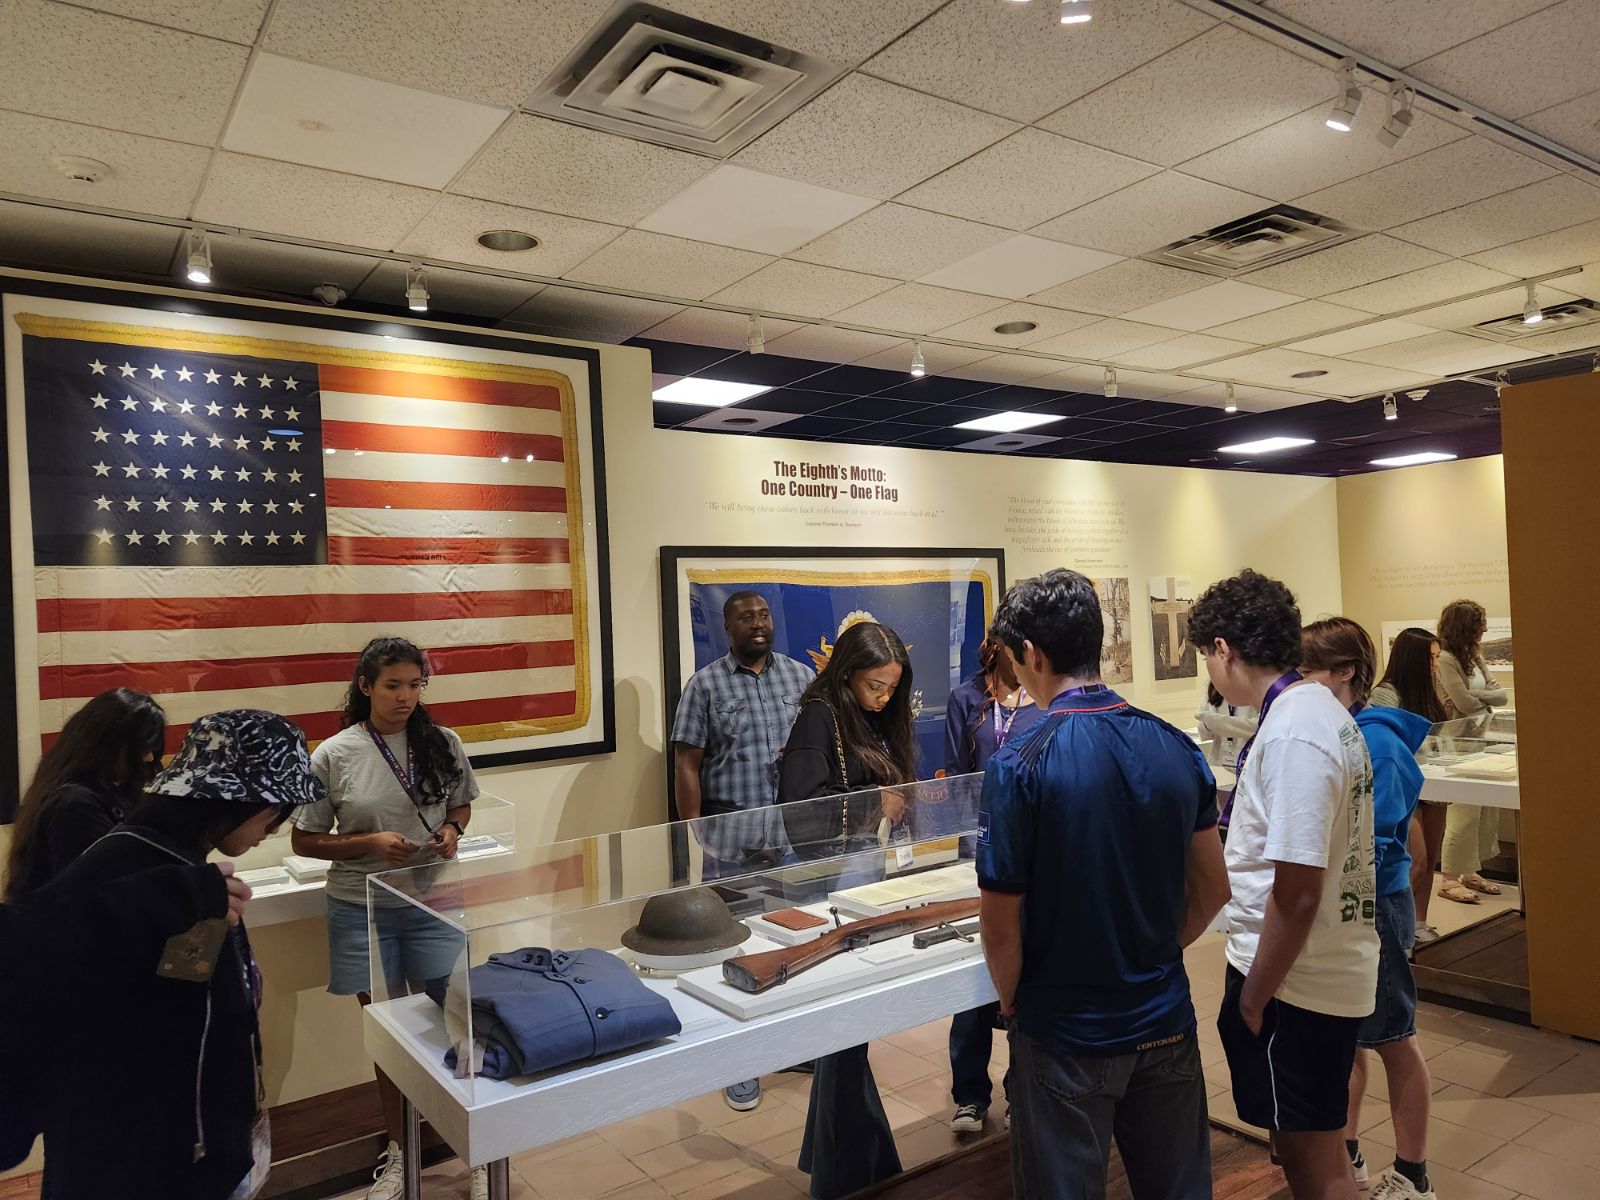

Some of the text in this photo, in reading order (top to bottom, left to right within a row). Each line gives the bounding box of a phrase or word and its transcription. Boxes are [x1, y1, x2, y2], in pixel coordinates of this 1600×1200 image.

[774, 460, 797, 477] The
[850, 466, 887, 482] Motto:
[761, 479, 786, 496] One
[789, 481, 837, 500] Country
[850, 484, 873, 499] One
[875, 485, 898, 502] Flag
